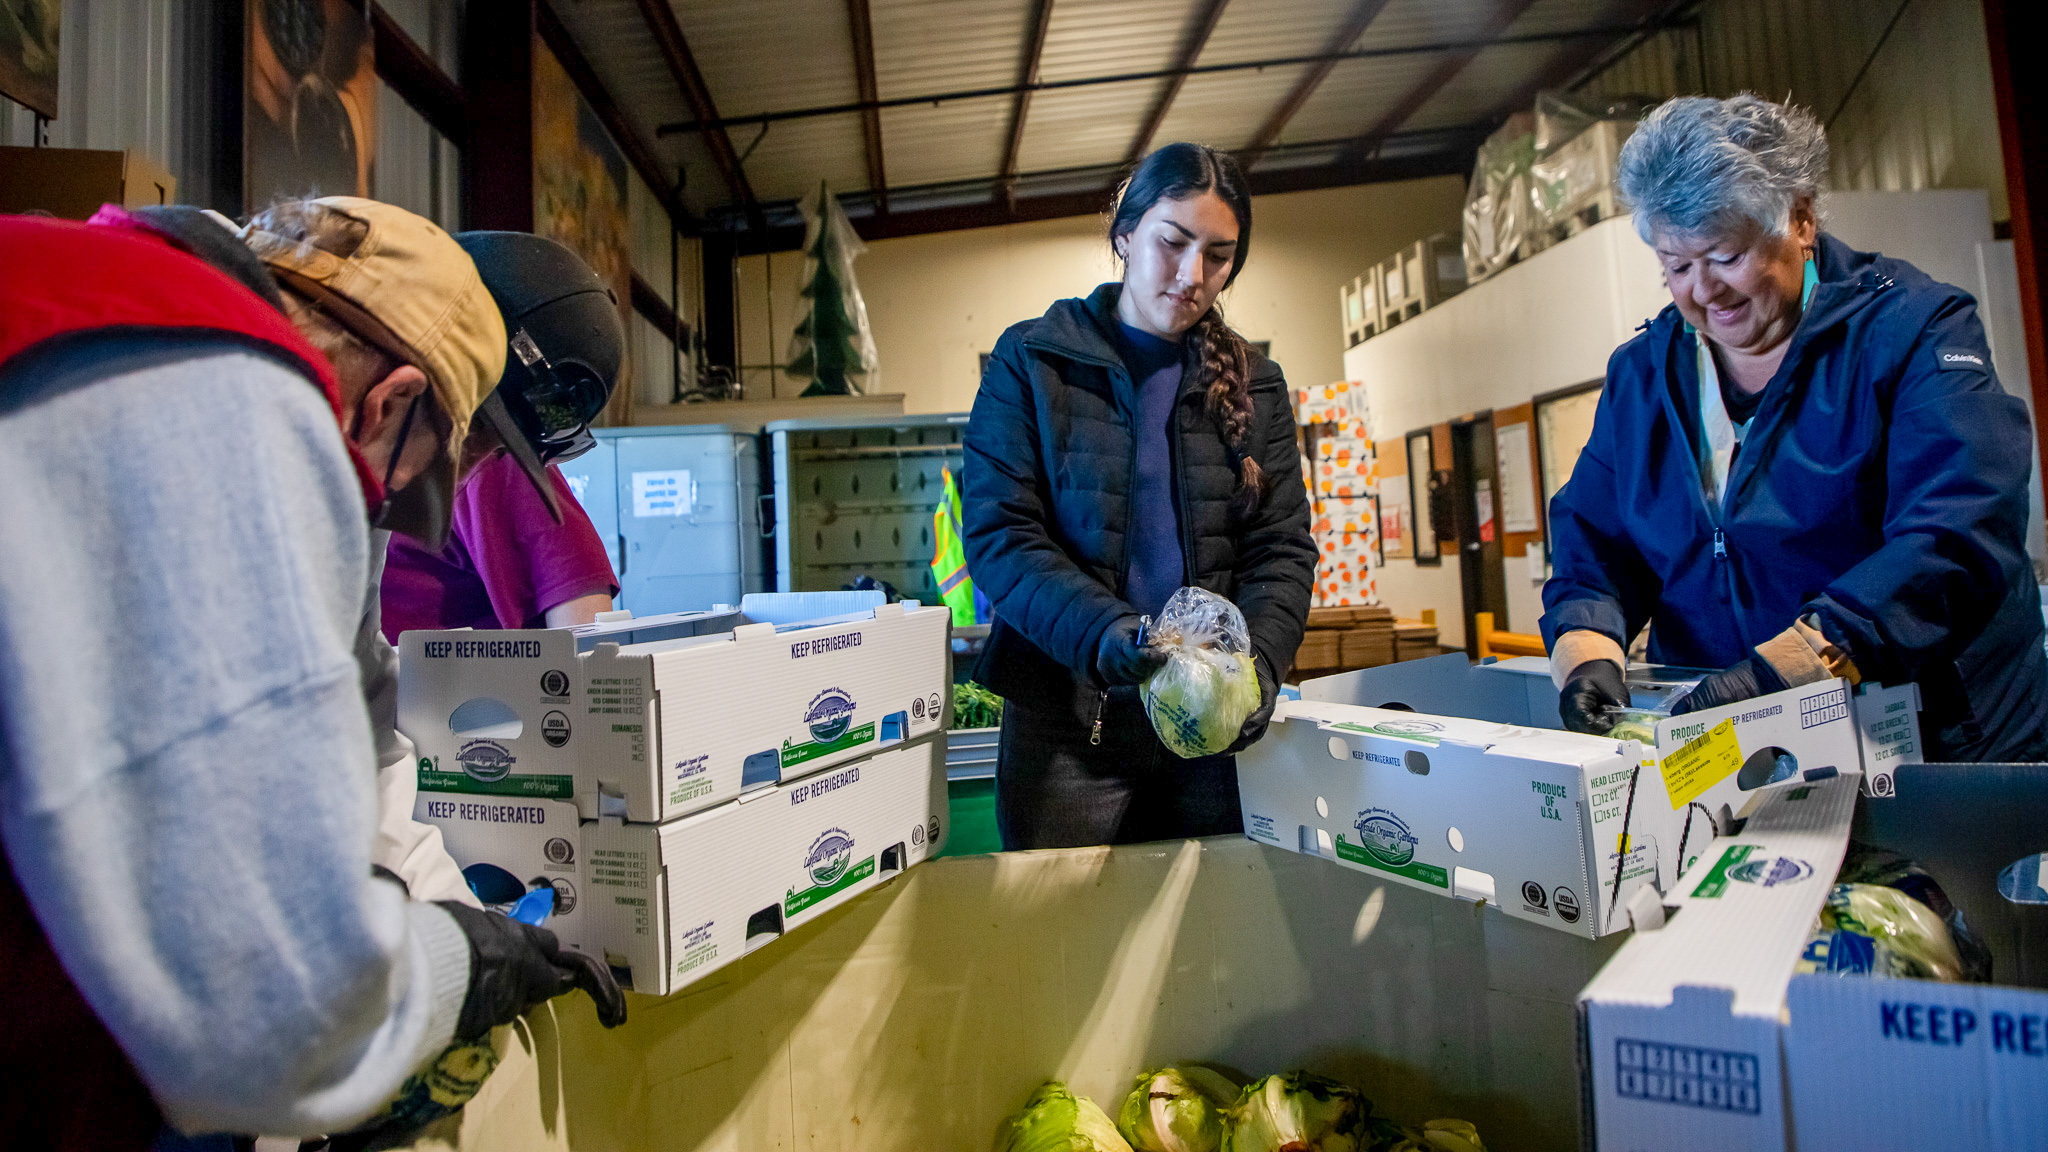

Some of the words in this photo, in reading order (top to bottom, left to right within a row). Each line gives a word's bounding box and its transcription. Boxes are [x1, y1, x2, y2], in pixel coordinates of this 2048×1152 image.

[424, 641, 452, 658] KEEP
[456, 641, 541, 658] REFRIGERATED
[791, 641, 810, 659] KEEP
[812, 632, 862, 655] REFRIGERATED
[1742, 705, 1783, 723] REFRIGERATED
[548, 720, 564, 728] USDA
[612, 724, 642, 732] ROMANESCO
[1671, 723, 1705, 740] PRODUCE
[1352, 750, 1364, 760] KEEP
[1365, 752, 1400, 767] REFRIGERATED
[1875, 752, 1882, 761] 12
[1890, 744, 1906, 756] SAVOY
[1680, 756, 1700, 771] ORGANIC
[790, 786, 809, 806] KEEP
[811, 768, 860, 798] REFRIGERATED
[1591, 778, 1608, 790] HEAD
[1608, 768, 1635, 786] LETTUCE
[670, 790, 693, 806] PRODUCE
[1531, 780, 1567, 799] PRODUCE
[1601, 793, 1608, 803] 12
[1610, 788, 1620, 800] CT.
[1544, 795, 1555, 807] OF
[429, 801, 456, 818] KEEP
[460, 803, 545, 824] REFRIGERATED
[1540, 806, 1562, 821] U.S.A.
[1603, 810, 1611, 821] 15
[1611, 806, 1622, 820] CT.
[1376, 825, 1397, 840] Organic
[1397, 830, 1420, 845] Gardens
[615, 896, 647, 907] ROMANESCO
[1558, 894, 1574, 905] USDA
[677, 958, 698, 976] PRODUCE
[1880, 1001, 1977, 1047] KEEP
[1991, 1011, 2048, 1057] RE
